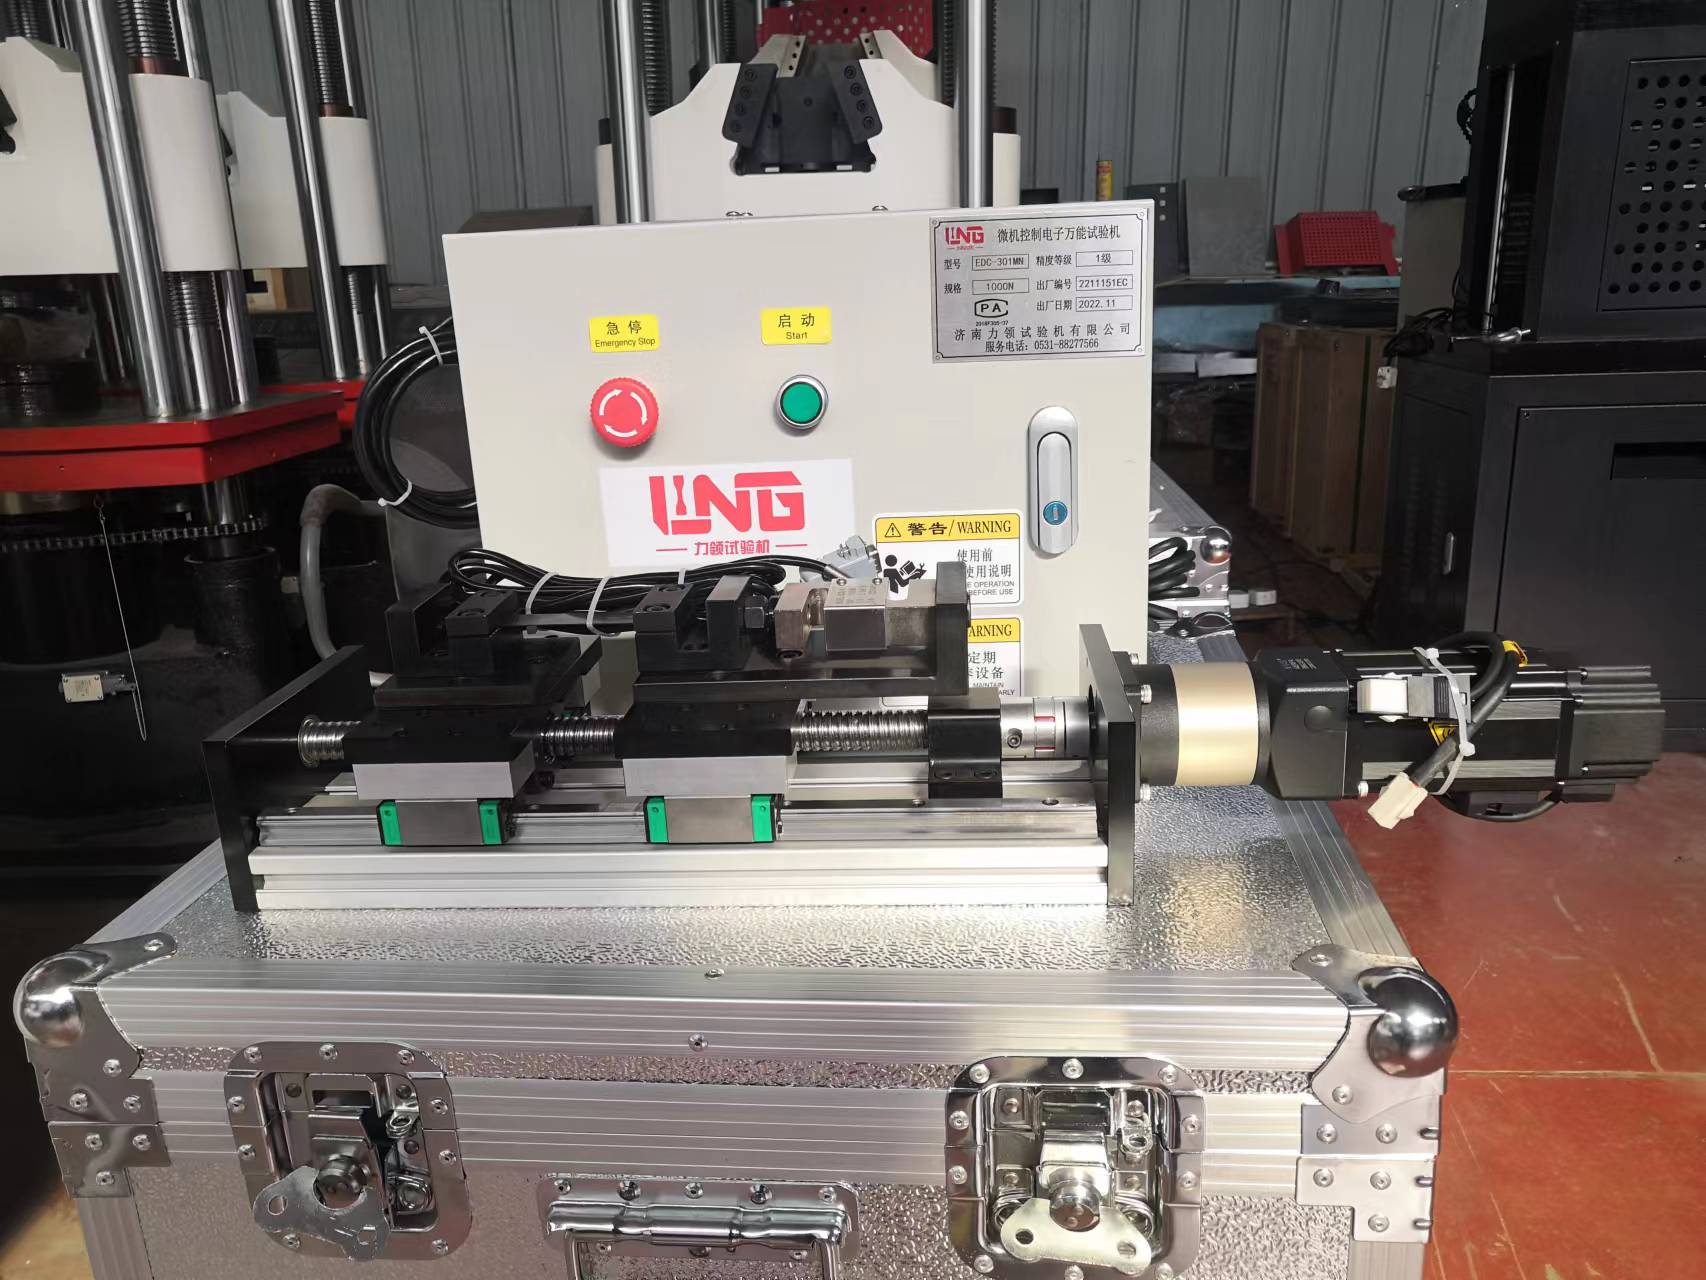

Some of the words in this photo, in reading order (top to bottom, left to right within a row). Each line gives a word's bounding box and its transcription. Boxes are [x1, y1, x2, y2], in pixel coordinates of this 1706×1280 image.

[997, 224, 1120, 243] 微机控制电子万能试验机
[944, 258, 961, 270] 型号
[975, 257, 1024, 267] EDC-301MN
[1036, 254, 1072, 266] 精度等级
[1096, 253, 1111, 263] 1级
[944, 282, 961, 294] 规格
[986, 282, 1014, 291] 1000N
[1036, 278, 1072, 290] 出厂编号
[1079, 278, 1128, 288] 2211151EC
[1036, 299, 1072, 311] 出厂日期
[1079, 299, 1115, 309] 2022.11
[778, 312, 815, 328] 启动
[606, 319, 642, 336] 急停
[954, 322, 1130, 341] 济南力领试验机有限公司
[786, 331, 808, 340] Start
[595, 337, 636, 348] Emergency
[638, 337, 656, 346] Stop
[694, 539, 770, 556] 力领试验机
[957, 547, 993, 562] 使用前
[968, 588, 997, 596] BEFORE
[968, 623, 1012, 638] ARNING
